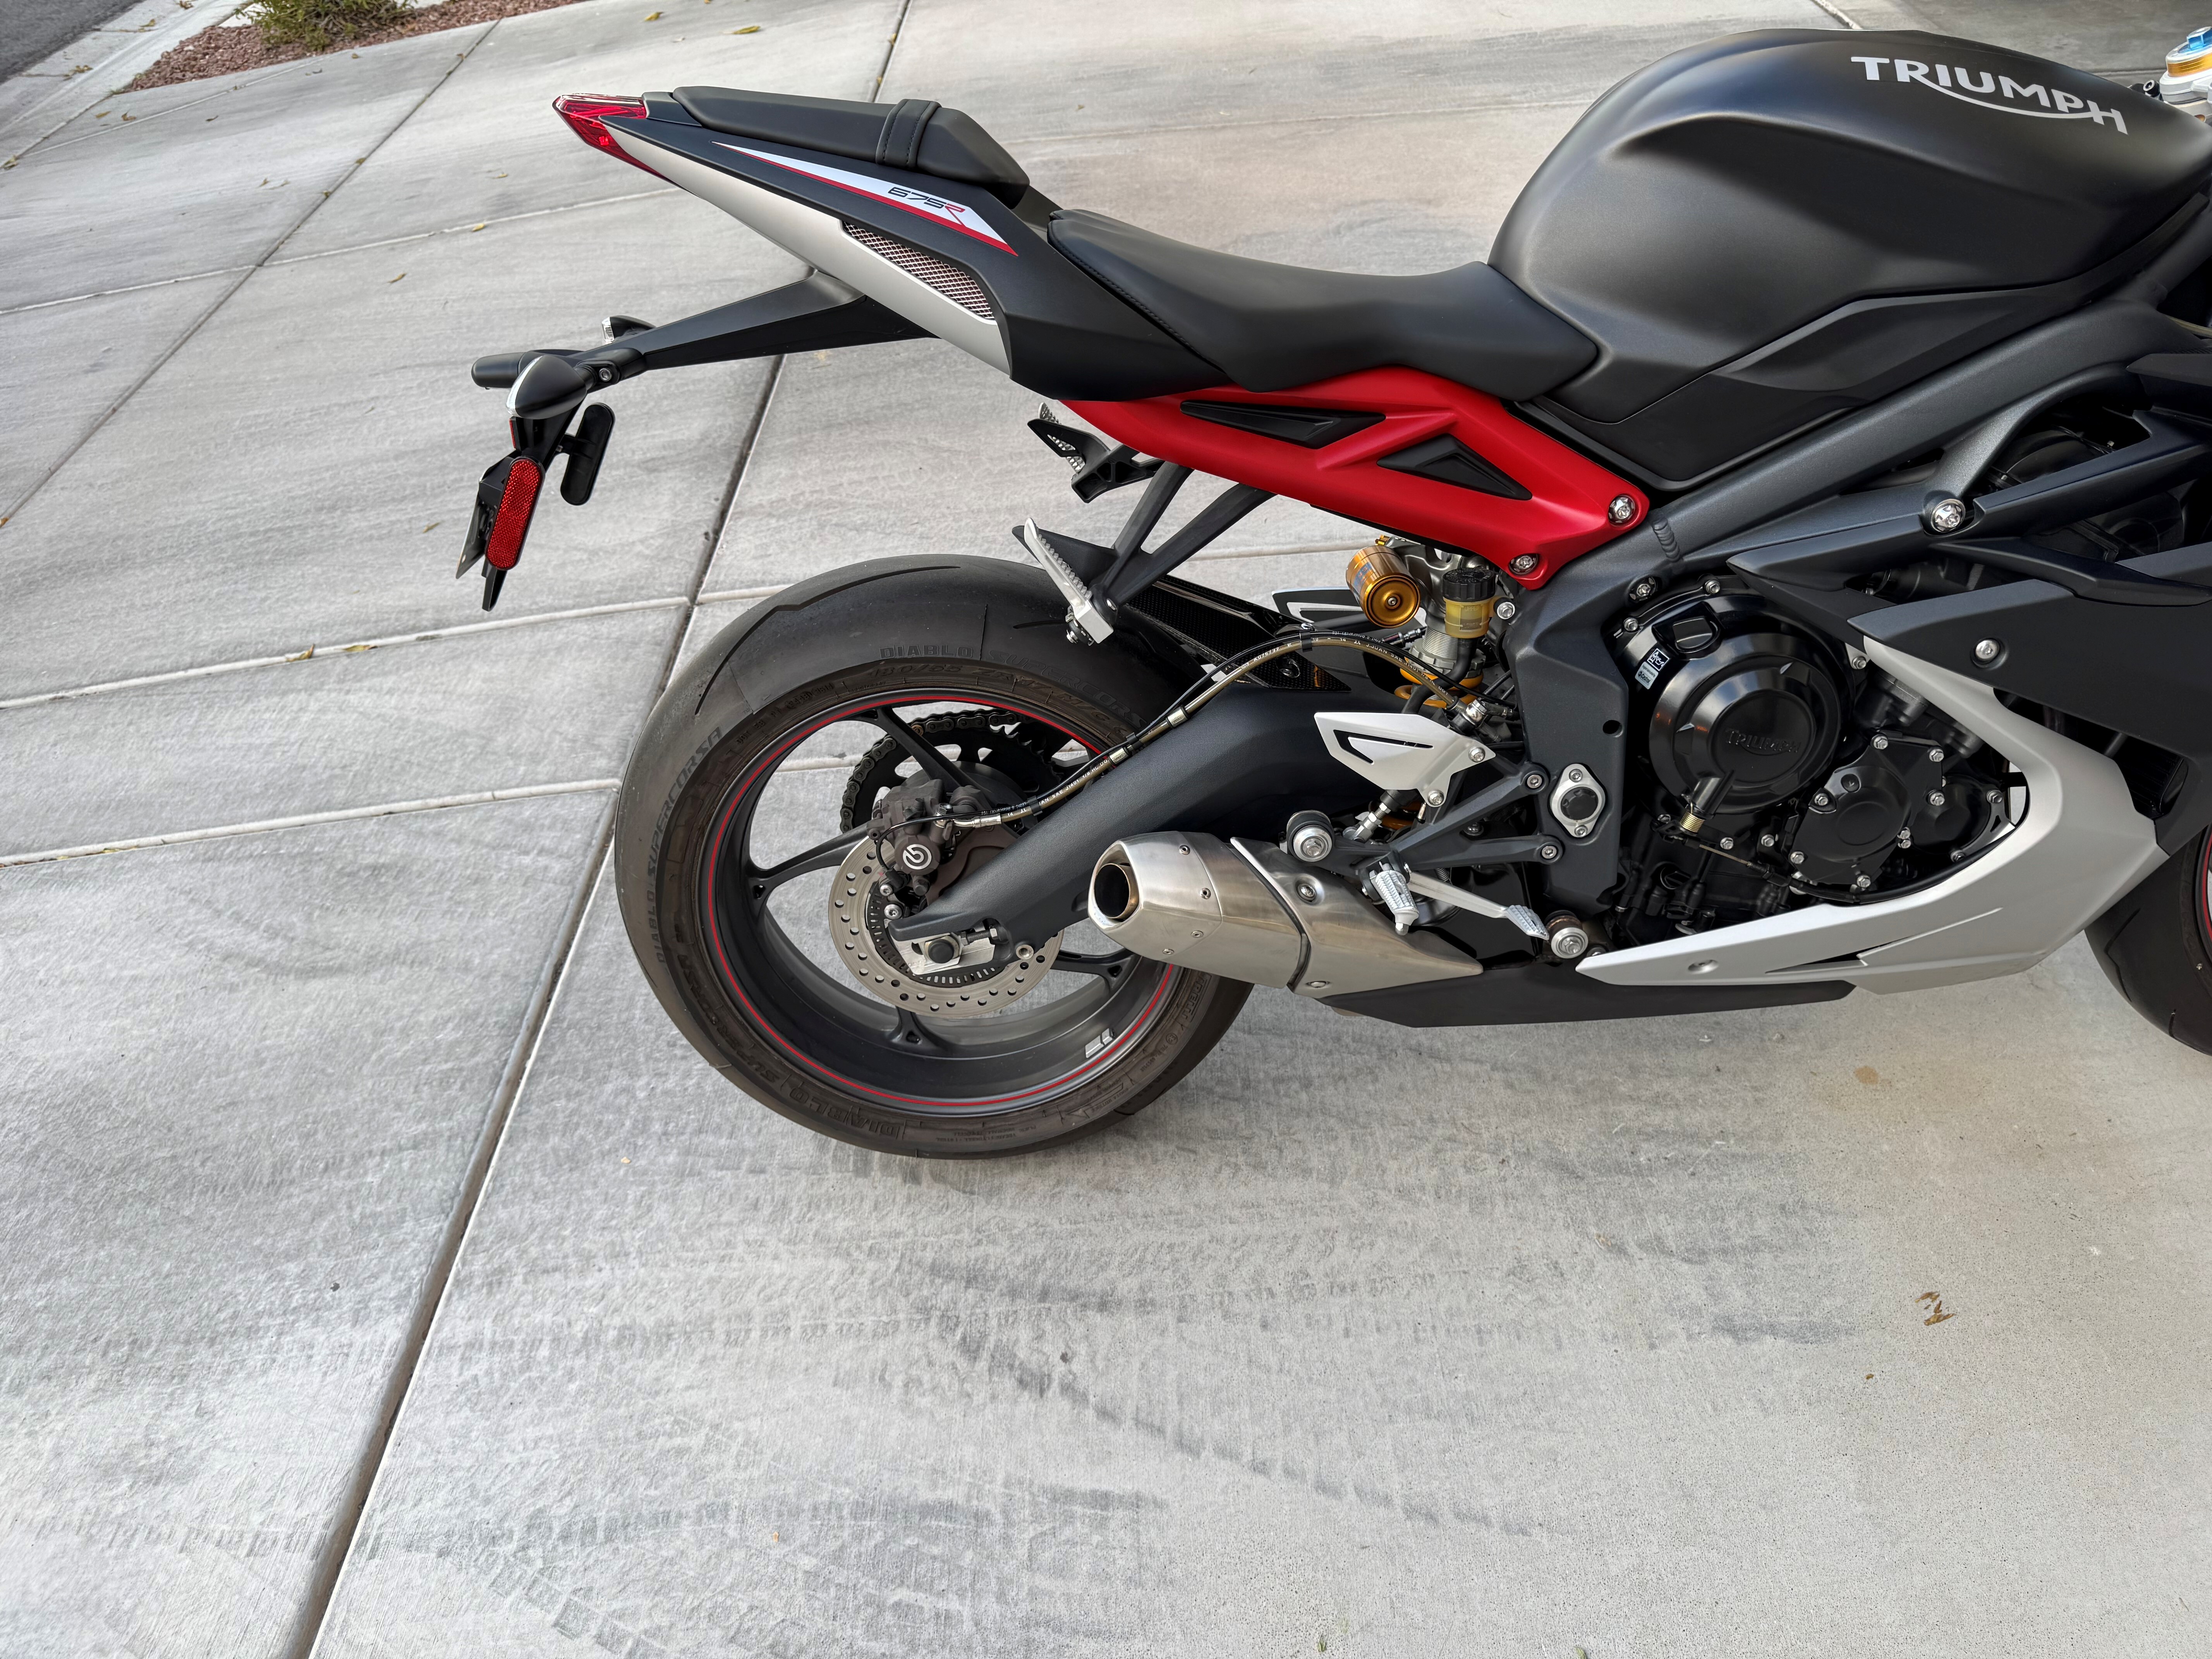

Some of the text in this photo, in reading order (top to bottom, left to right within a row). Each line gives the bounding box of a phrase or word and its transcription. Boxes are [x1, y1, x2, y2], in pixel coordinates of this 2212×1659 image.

[1851, 56, 2128, 135] TRIUMPH
[888, 187, 966, 227] 675R
[879, 644, 1147, 728] DIABLO SUPERCORS
[1725, 727, 1802, 754] TRIUMPH
[1052, 789, 1064, 798] SAE
[646, 726, 723, 963] DIABLO SUPERCORSA
[789, 1086, 898, 1139] DIABLO
